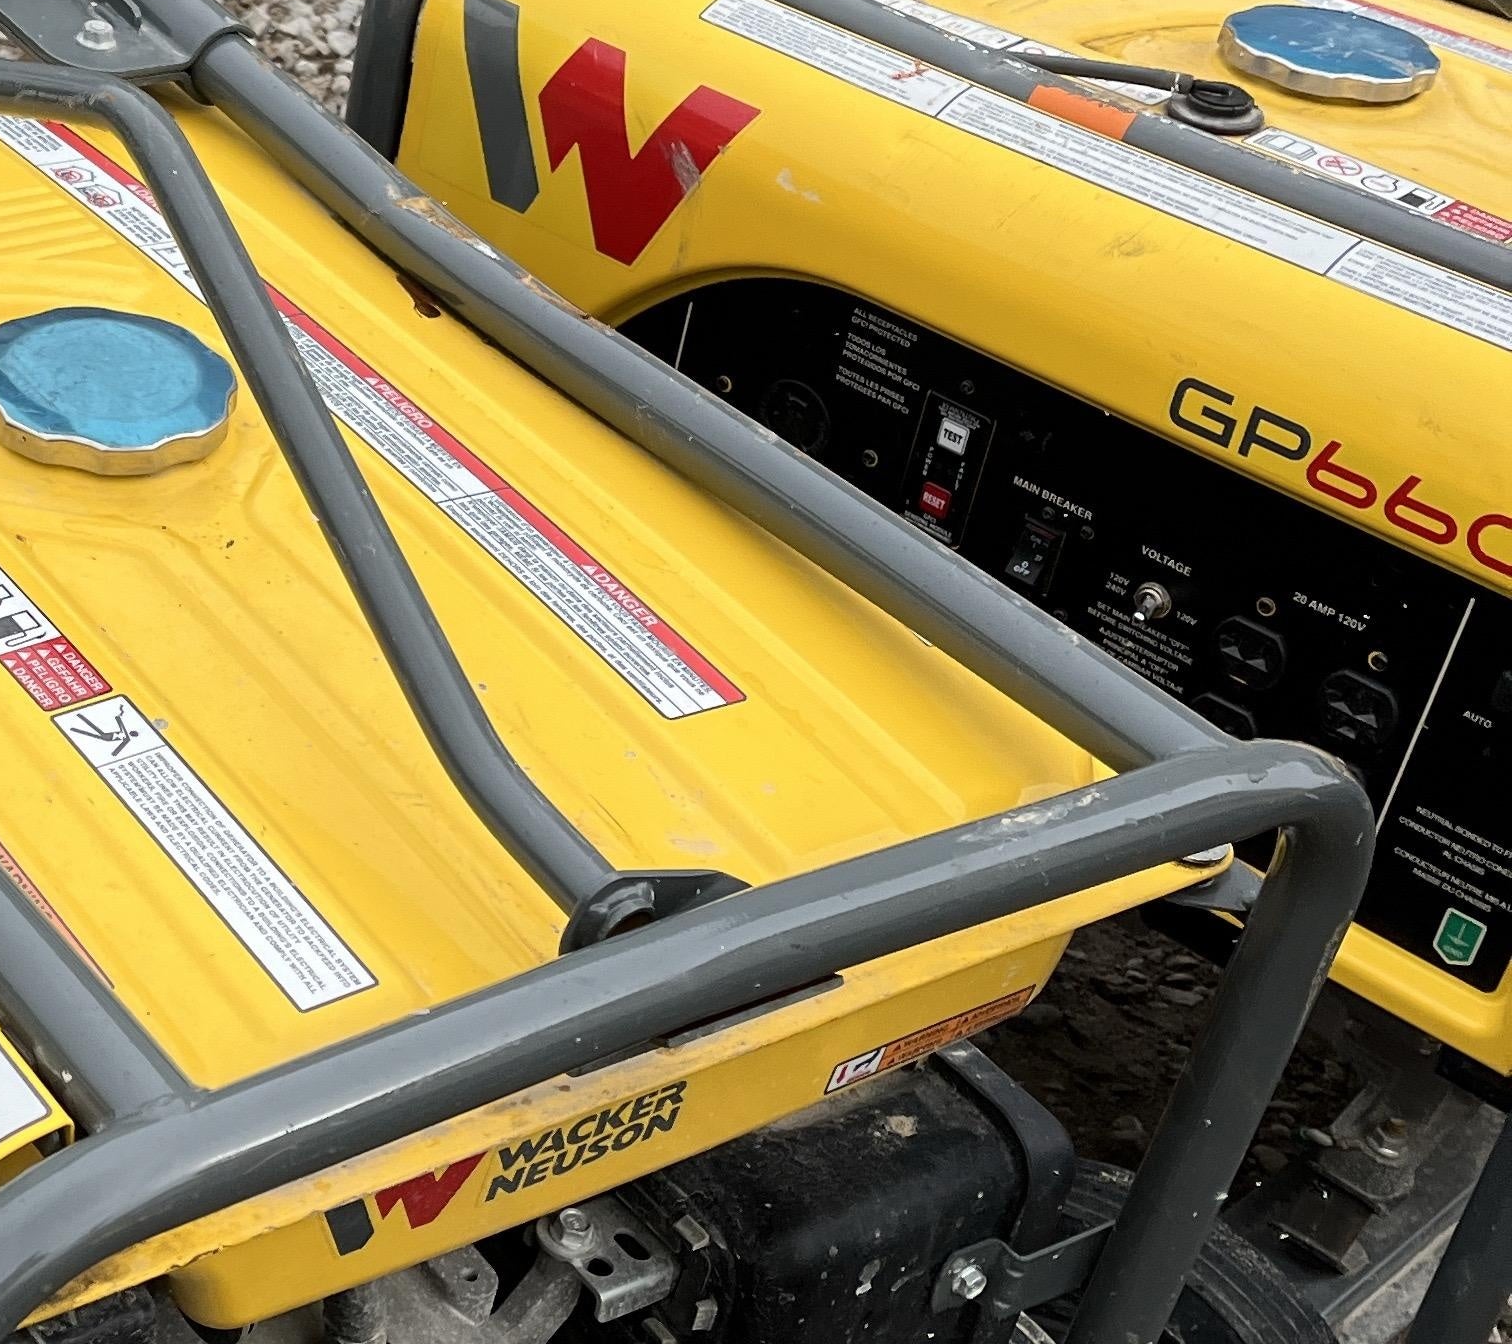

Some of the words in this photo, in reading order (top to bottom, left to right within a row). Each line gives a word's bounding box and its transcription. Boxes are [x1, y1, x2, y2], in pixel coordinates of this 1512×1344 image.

[372, 383, 435, 429] PELIGRO
[943, 428, 963, 445] TEST
[923, 490, 945, 511] RESET
[1012, 475, 1040, 495] MAIN
[1040, 488, 1093, 521] BREAKER
[1141, 545, 1192, 577] VOLTAGE
[590, 573, 660, 626] DANGER
[1292, 591, 1307, 605] 20
[1308, 600, 1336, 617] AMP
[1338, 613, 1367, 632] 120V
[11, 666, 55, 707] DANGER
[25, 658, 73, 704] PELIGRO
[45, 656, 88, 696] GEFAHR
[61, 651, 105, 691] DANGER
[1462, 709, 1492, 730] AUTO
[108, 767, 142, 802] APPLICABLE
[139, 803, 158, 820] LAWS
[154, 820, 169, 833] AND
[165, 834, 201, 871] ELECTRICAL
[135, 758, 157, 779] UTILITY
[171, 799, 187, 813] THIS
[183, 813, 198, 826] MAY
[195, 826, 218, 849] RESULT
[222, 858, 270, 909] ELECTROCUTION
[267, 909, 279, 919] OF
[276, 919, 301, 944] UTILITY
[144, 755, 159, 768] CAN
[155, 768, 177, 788] ALLOW
[174, 788, 209, 824] ELECTRICAL
[206, 825, 235, 854] CURRENT
[231, 854, 251, 872] FROM
[247, 873, 262, 886] THE
[259, 886, 297, 925] GENERATOR
[293, 924, 305, 934] TO
[302, 935, 337, 971] BACKFEED
[333, 970, 352, 988] INTO
[153, 751, 183, 781] IMPROPER
[180, 782, 217, 820] CONNECTION
[213, 820, 224, 828] OF
[221, 829, 258, 866] GENERATOR
[254, 867, 266, 876] TO
[267, 882, 303, 918] BUILDING'S
[299, 918, 338, 958] ELECTRICAL
[334, 958, 362, 985] SYSTEM
[152, 804, 163, 813] BE
[160, 814, 178, 831] MADE
[175, 831, 186, 840] BY
[187, 846, 219, 879] QUALIFIED
[216, 879, 255, 920] ELECTRICIAN
[251, 920, 268, 935] AND
[264, 935, 291, 962] COMPLY
[287, 962, 307, 980] WITH
[302, 980, 318, 994] ALL
[497, 1080, 687, 1172] WACKER
[485, 1106, 681, 1204] NEUSON
